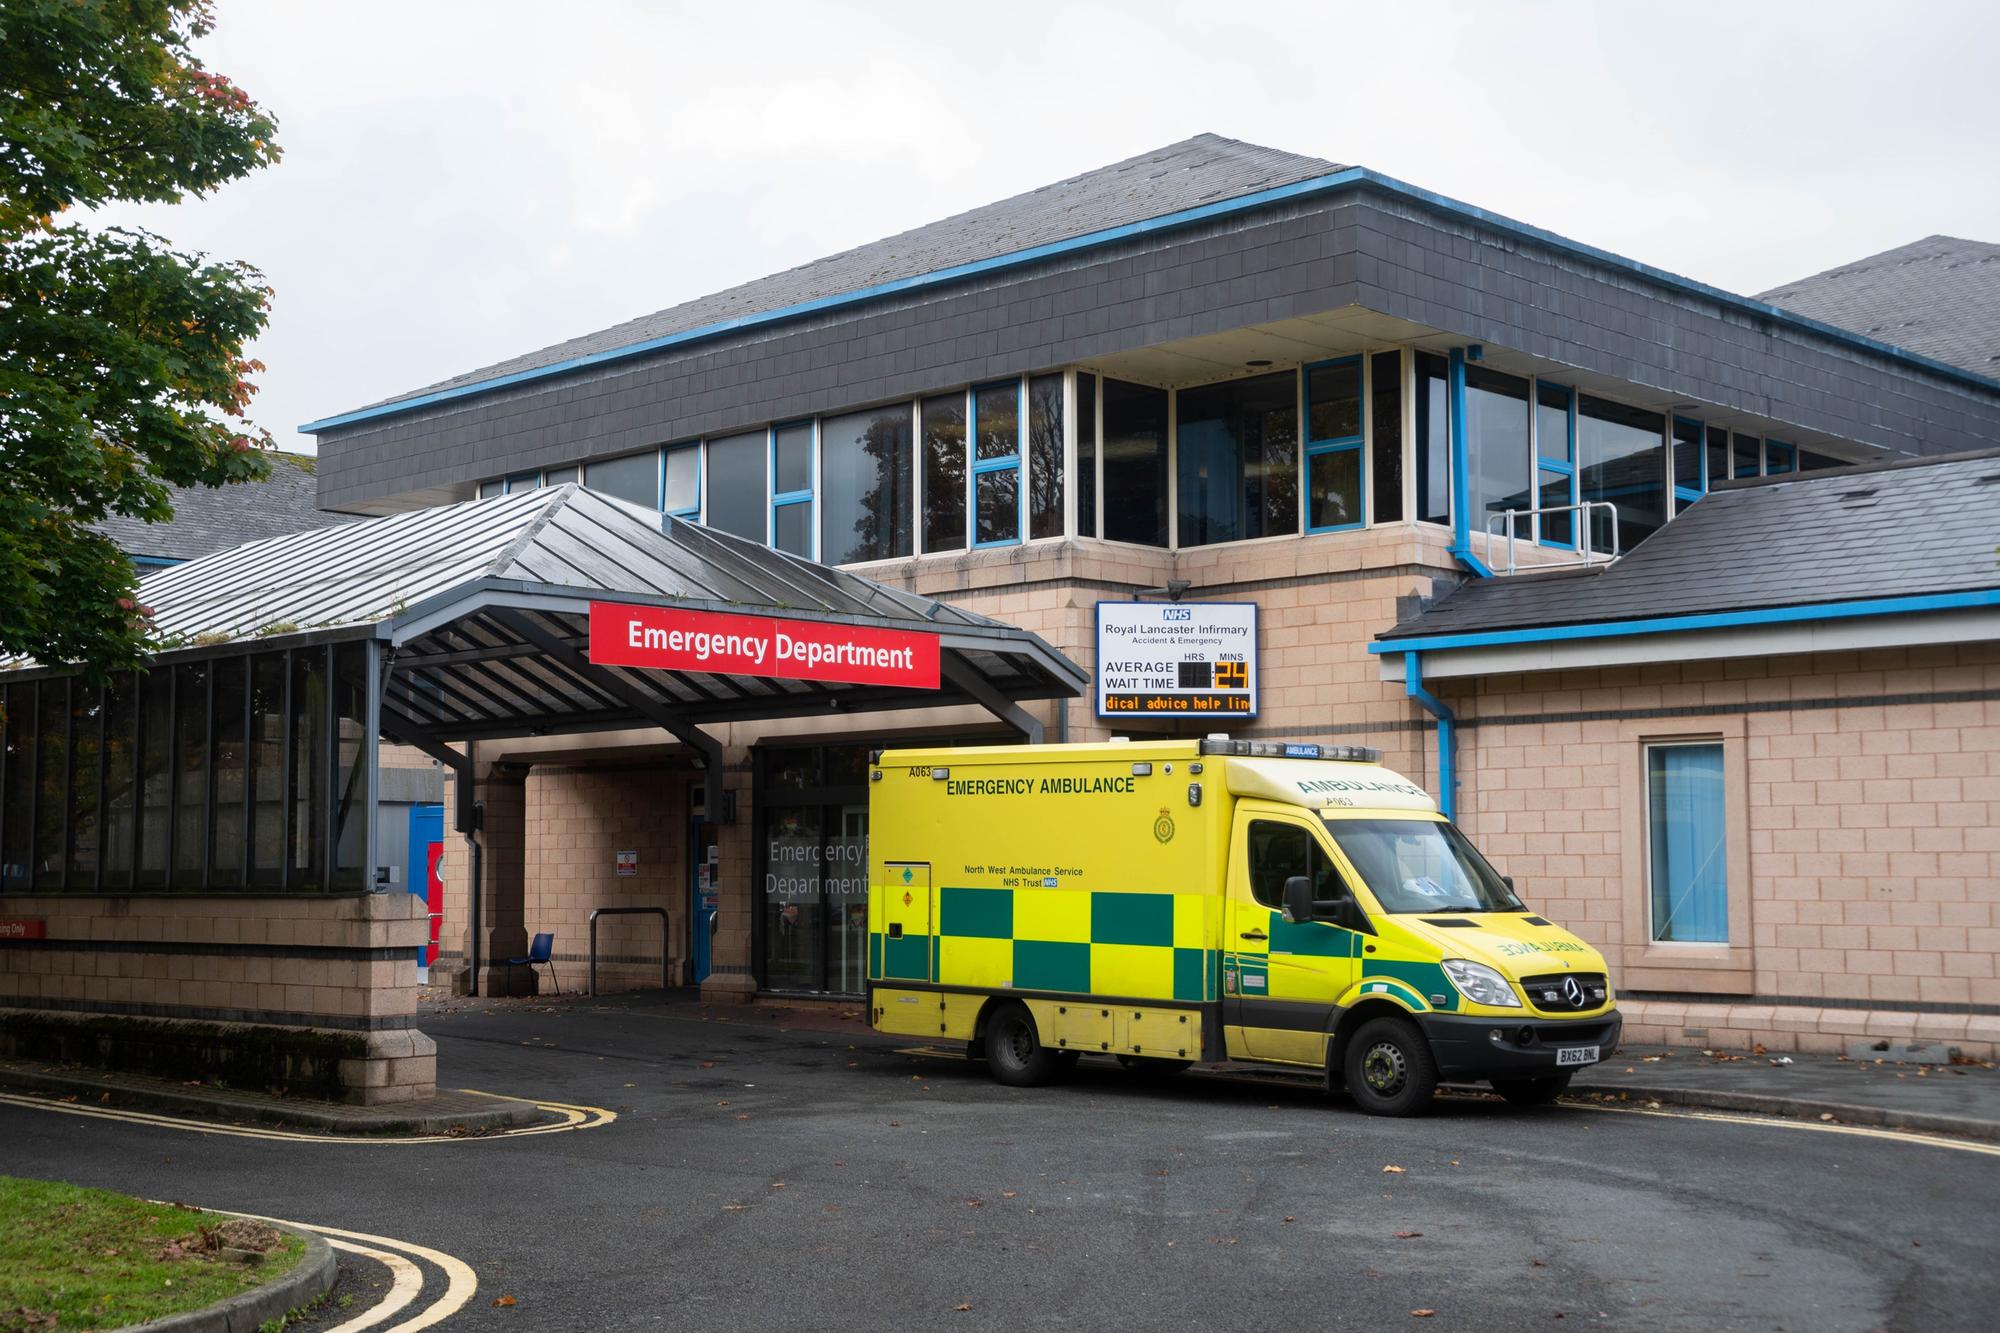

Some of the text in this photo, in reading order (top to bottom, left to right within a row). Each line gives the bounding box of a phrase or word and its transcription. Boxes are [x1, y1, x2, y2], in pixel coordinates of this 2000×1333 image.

[1163, 609, 1190, 620] NHS
[1105, 624, 1248, 636] Royal Lancaster Infirmary
[628, 620, 913, 670] Emergency Department
[1132, 637, 1223, 646] Accident & Emergency
[1184, 653, 1244, 661] HRS MINS
[1105, 662, 1174, 673] AVERAGE
[1215, 662, 1248, 688] 24
[1105, 678, 1174, 688] WAIT TIME
[1106, 697, 1139, 710] dical
[1147, 697, 1187, 710] advice
[1194, 697, 1221, 710] help
[1286, 745, 1318, 757] AMBULANCE
[909, 766, 931, 778] A063
[947, 777, 1135, 796] EMERGENCY AMBULANCE
[1296, 780, 1428, 798] AMBULANCE
[964, 865, 1083, 876] North West Ambulance Service
[1003, 877, 1057, 887] NHS Trust NHS
[1560, 1049, 1597, 1062] BX62 BNL
